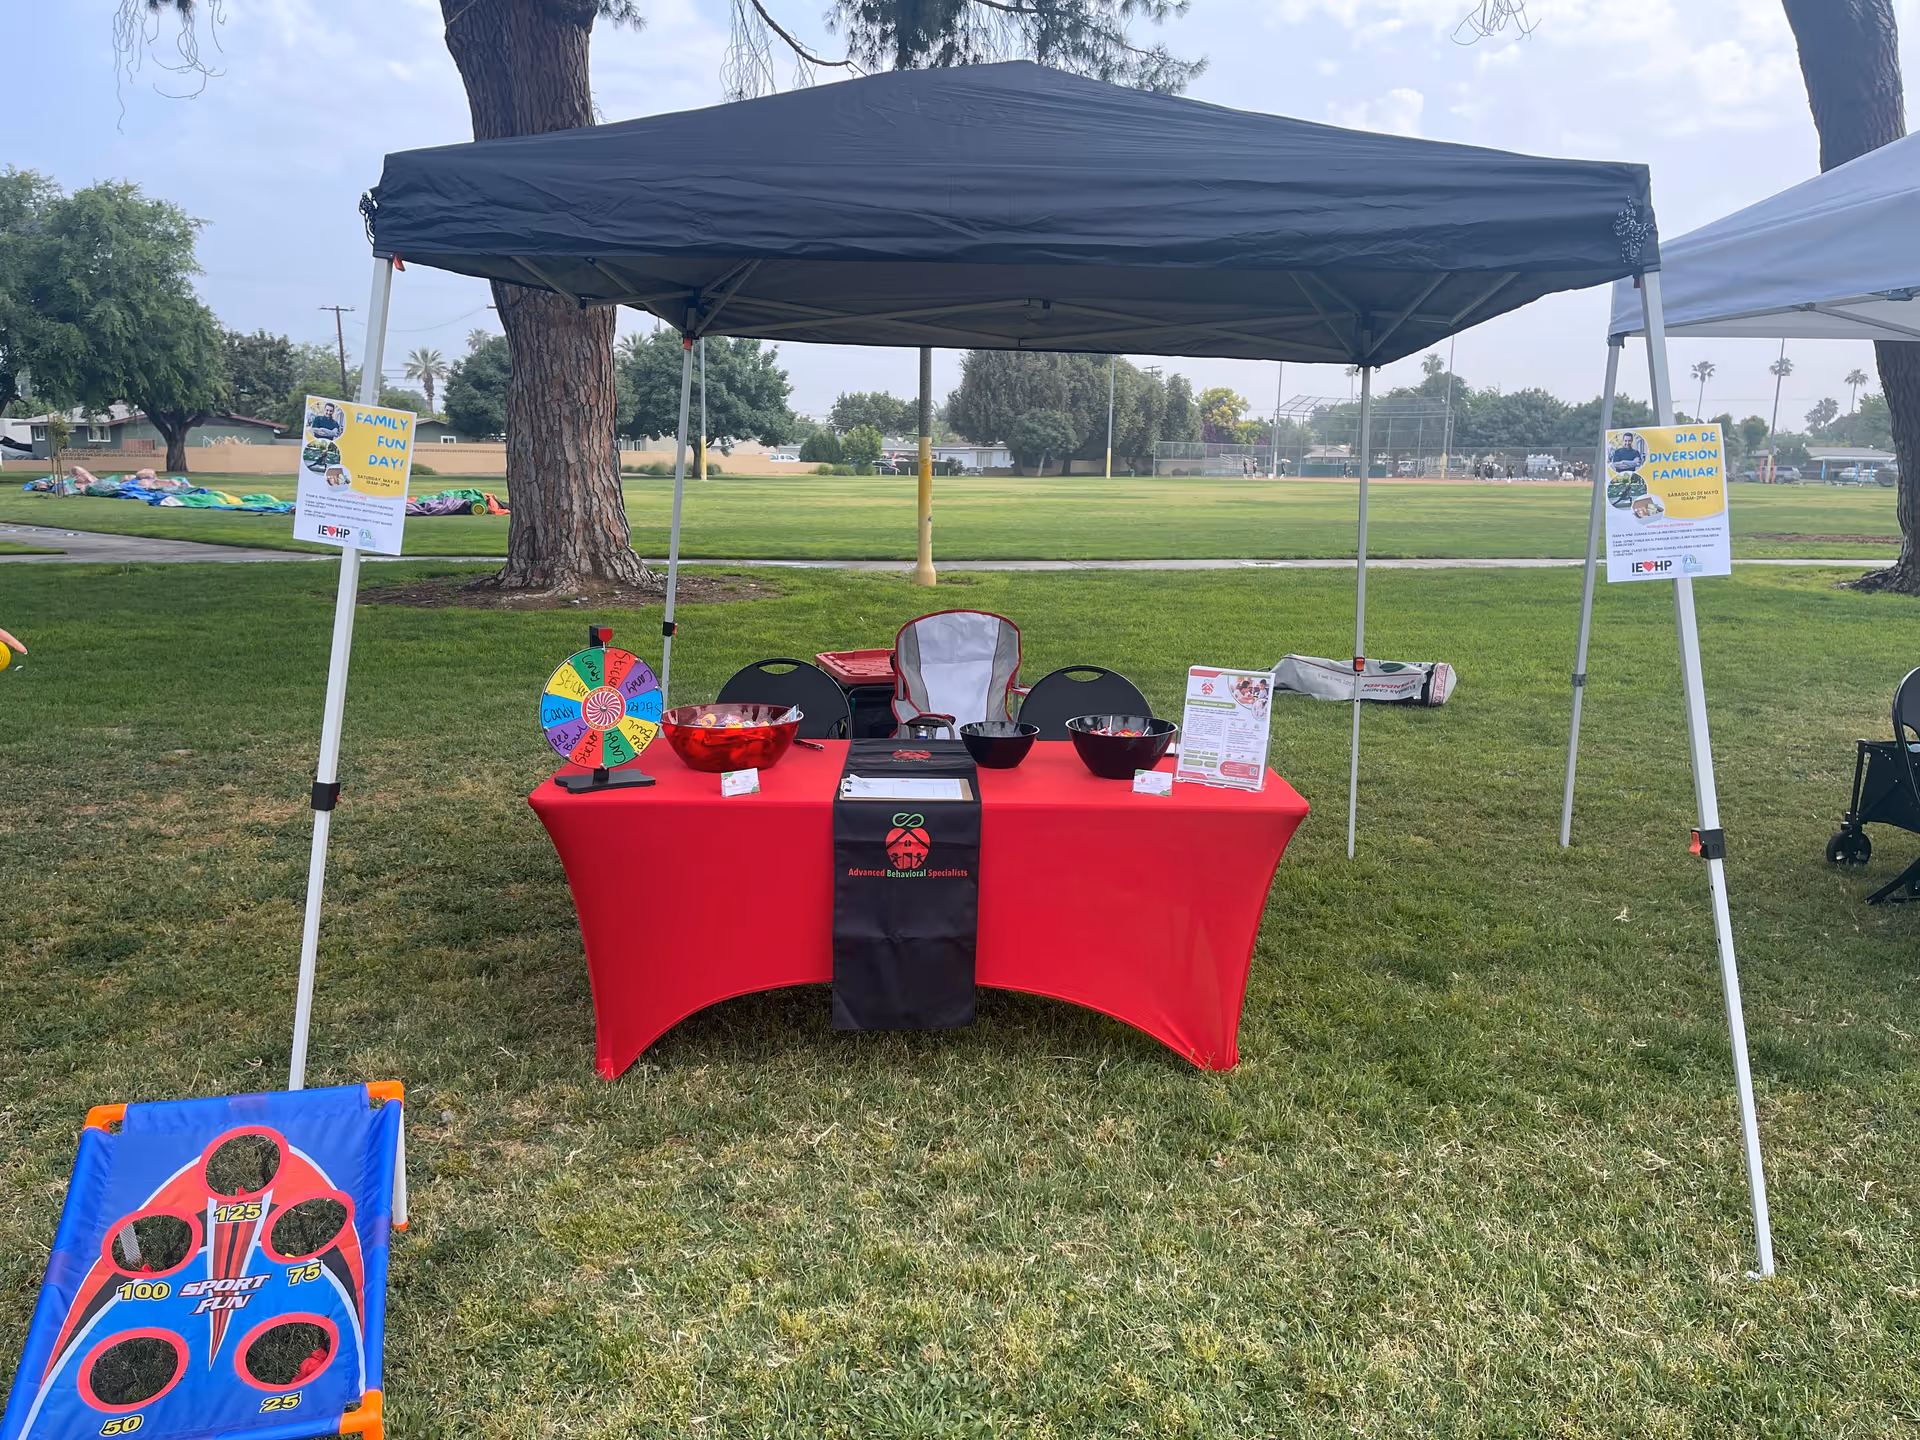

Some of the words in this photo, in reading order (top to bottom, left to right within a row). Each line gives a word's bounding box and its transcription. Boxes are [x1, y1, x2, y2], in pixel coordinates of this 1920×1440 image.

[356, 412, 408, 431] FAMILY
[377, 436, 406, 450] FUN
[1701, 432, 1716, 442] DE
[368, 454, 404, 471] DAY!
[1650, 448, 1718, 463] DIVERSIÓN
[1652, 466, 1719, 481] FAMILIAR!
[582, 654, 600, 682] Candy
[608, 652, 630, 688] Sticker
[556, 669, 588, 698] Sticker
[626, 670, 653, 694] Candy
[543, 704, 575, 723] Candy
[626, 702, 663, 715] Sticker
[551, 730, 569, 750] Red
[564, 725, 588, 752] Bowl
[575, 731, 598, 764] Sticker
[604, 730, 626, 764] Candy
[848, 868, 885, 877] Advanced
[886, 869, 927, 878] Behavioral
[927, 869, 968, 879] Specialists
[213, 1203, 262, 1224] 125
[287, 1260, 323, 1286] 75
[117, 1282, 170, 1300] 100
[177, 1274, 273, 1298] SPORT
[189, 1292, 254, 1315] FUN
[259, 1391, 302, 1412] 25
[100, 1414, 144, 1436] 50
